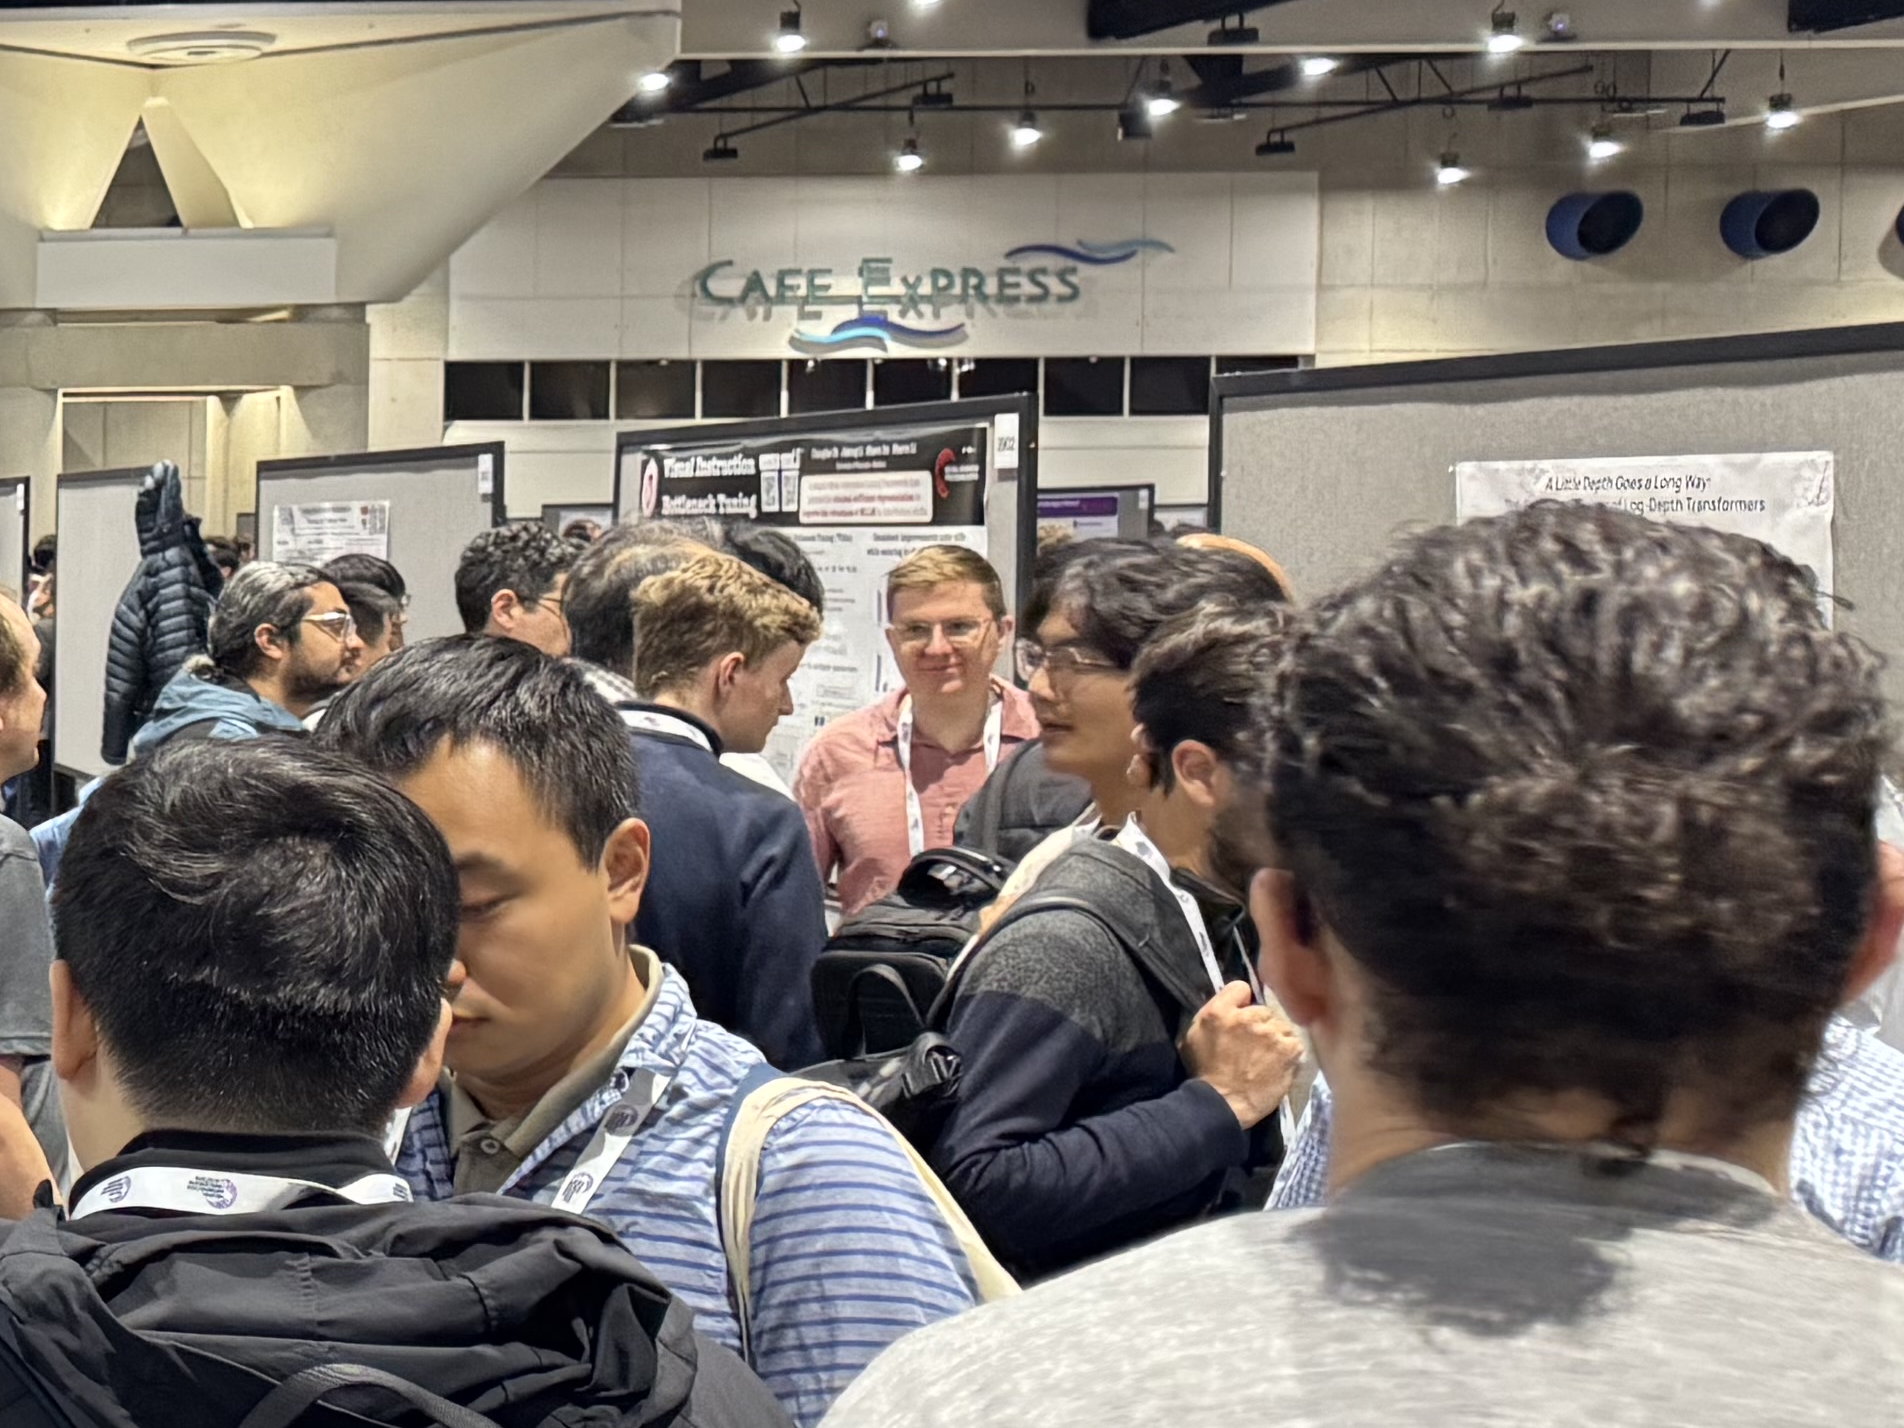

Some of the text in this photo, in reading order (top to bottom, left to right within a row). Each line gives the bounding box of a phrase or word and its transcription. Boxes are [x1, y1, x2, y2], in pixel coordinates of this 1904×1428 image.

[700, 257, 1080, 304] CAFE EXPRESS
[664, 453, 756, 478] Visual Instruction
[1545, 476, 1554, 491] A
[1583, 475, 1613, 494] Depth
[1616, 474, 1642, 491] Goes
[1654, 475, 1682, 494] Long
[717, 492, 758, 519] Tuning
[1686, 497, 1766, 513] Transformers
